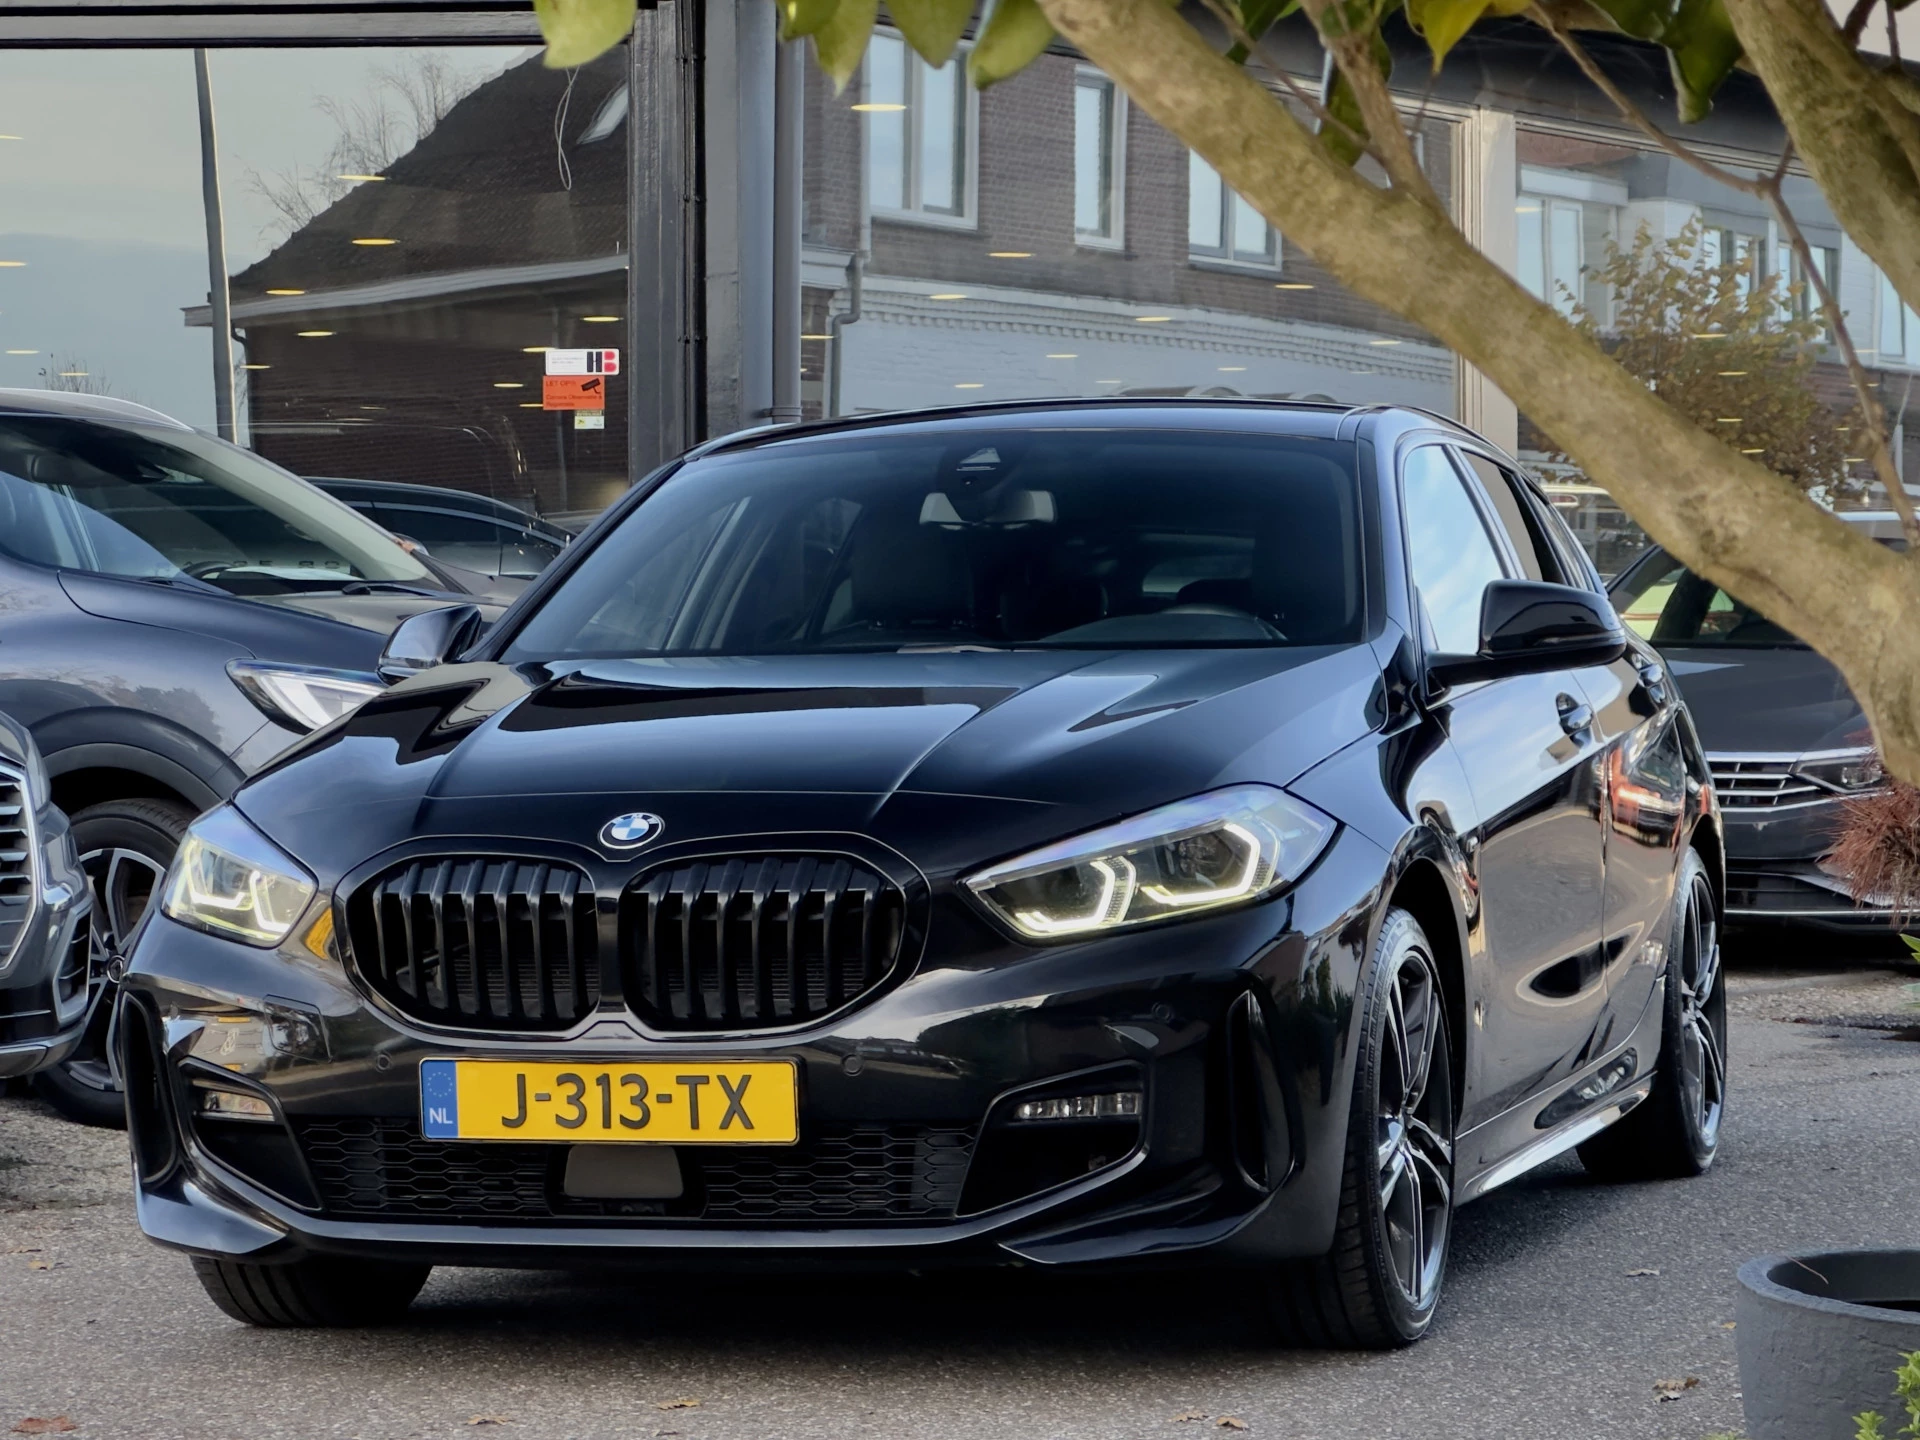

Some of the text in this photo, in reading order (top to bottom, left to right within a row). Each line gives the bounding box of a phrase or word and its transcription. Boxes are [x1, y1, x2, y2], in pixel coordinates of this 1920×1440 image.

[610, 812, 661, 825] BMW
[501, 1073, 755, 1130] J-313-TX
[429, 1107, 453, 1125] NL
